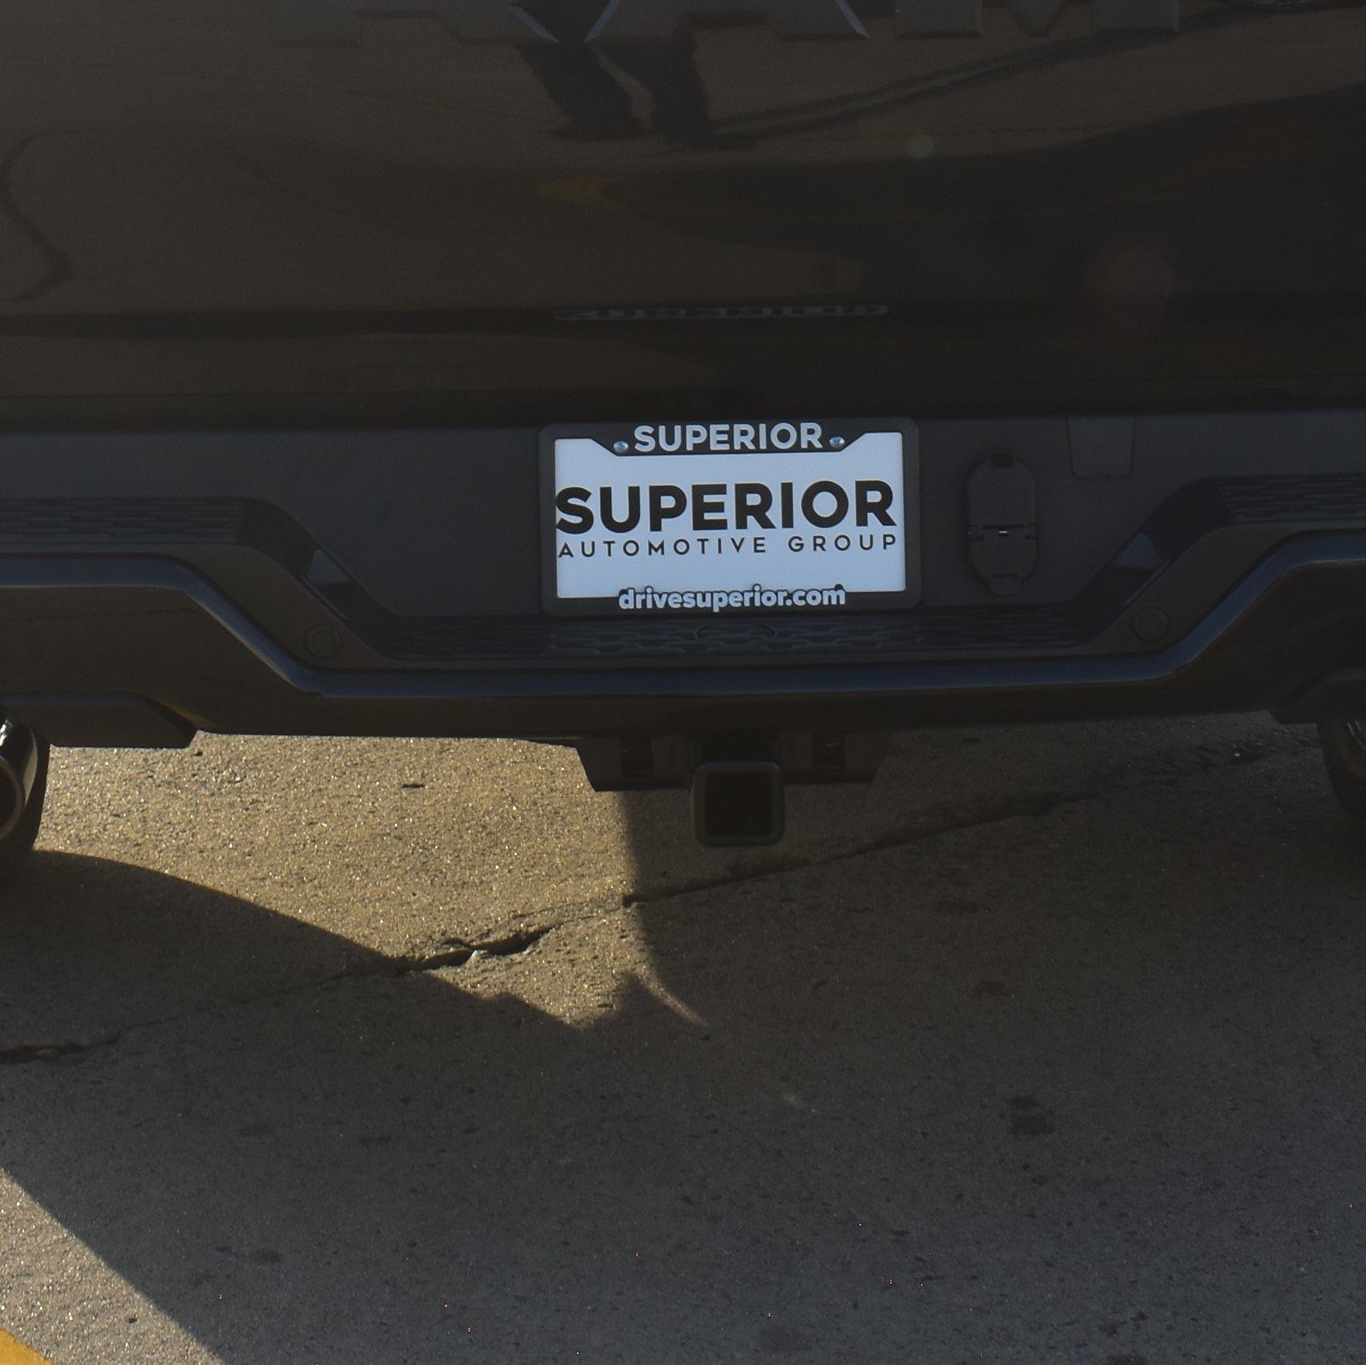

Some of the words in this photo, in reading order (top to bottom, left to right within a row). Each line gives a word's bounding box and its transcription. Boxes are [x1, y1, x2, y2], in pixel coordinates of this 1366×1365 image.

[634, 422, 823, 453] SUPERIOR
[554, 479, 898, 534] SUPERIOR
[558, 536, 766, 558] AUTOMOTIVE
[787, 533, 897, 553] GROUP
[618, 584, 846, 612] drivesuperior.com
